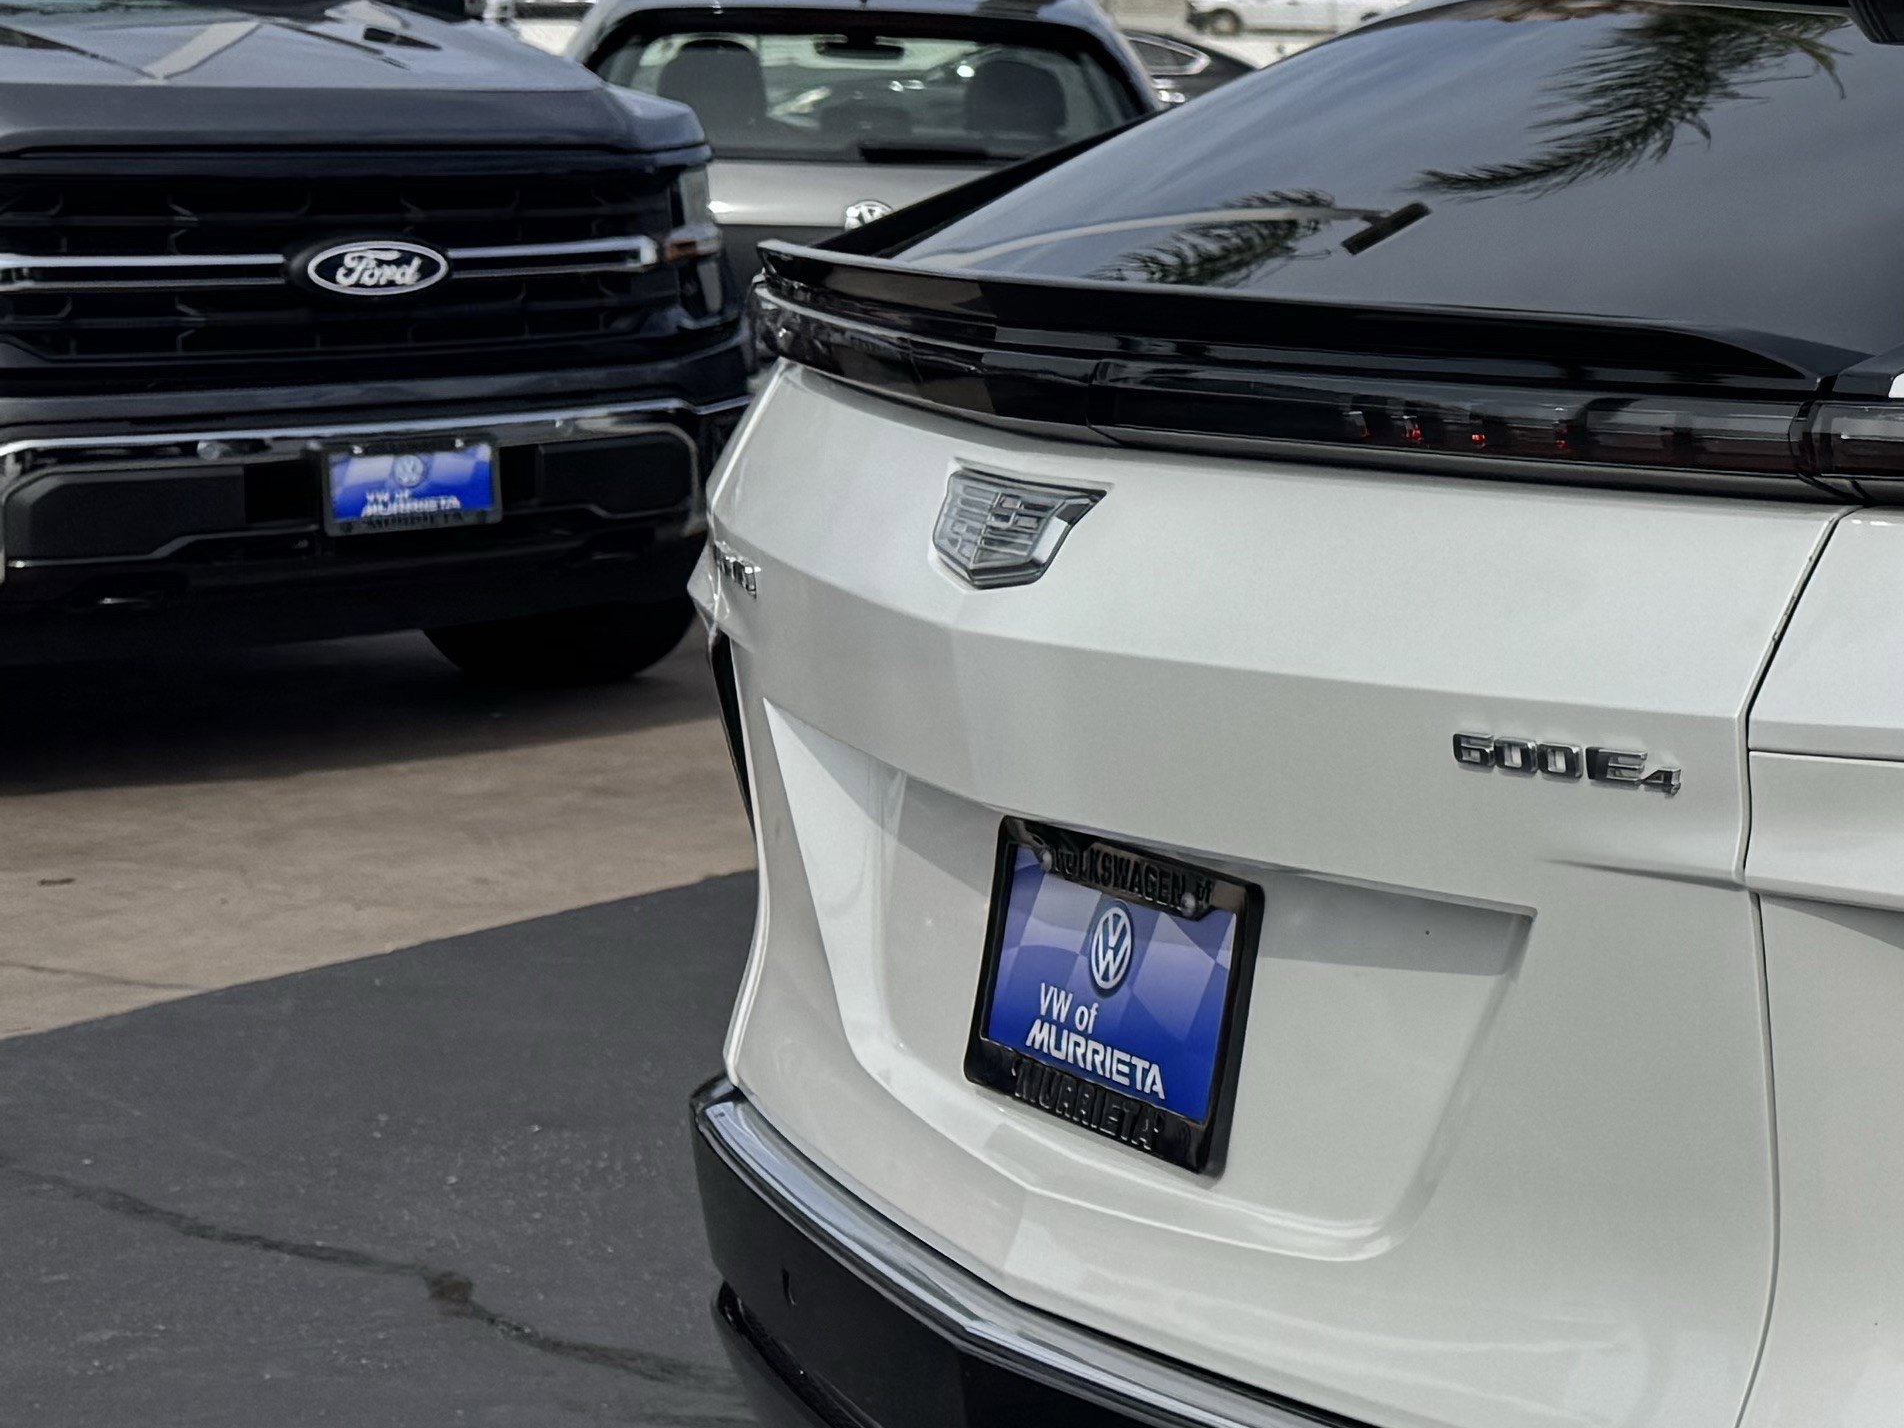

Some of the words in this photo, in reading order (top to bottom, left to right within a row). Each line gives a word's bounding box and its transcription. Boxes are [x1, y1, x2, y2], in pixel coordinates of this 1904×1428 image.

[336, 249, 422, 287] Ford
[1040, 982, 1073, 1024] VW
[1075, 1002, 1099, 1035] of
[1025, 1019, 1166, 1100] MURRIETA
[1014, 1057, 1153, 1152] MURRIETA
